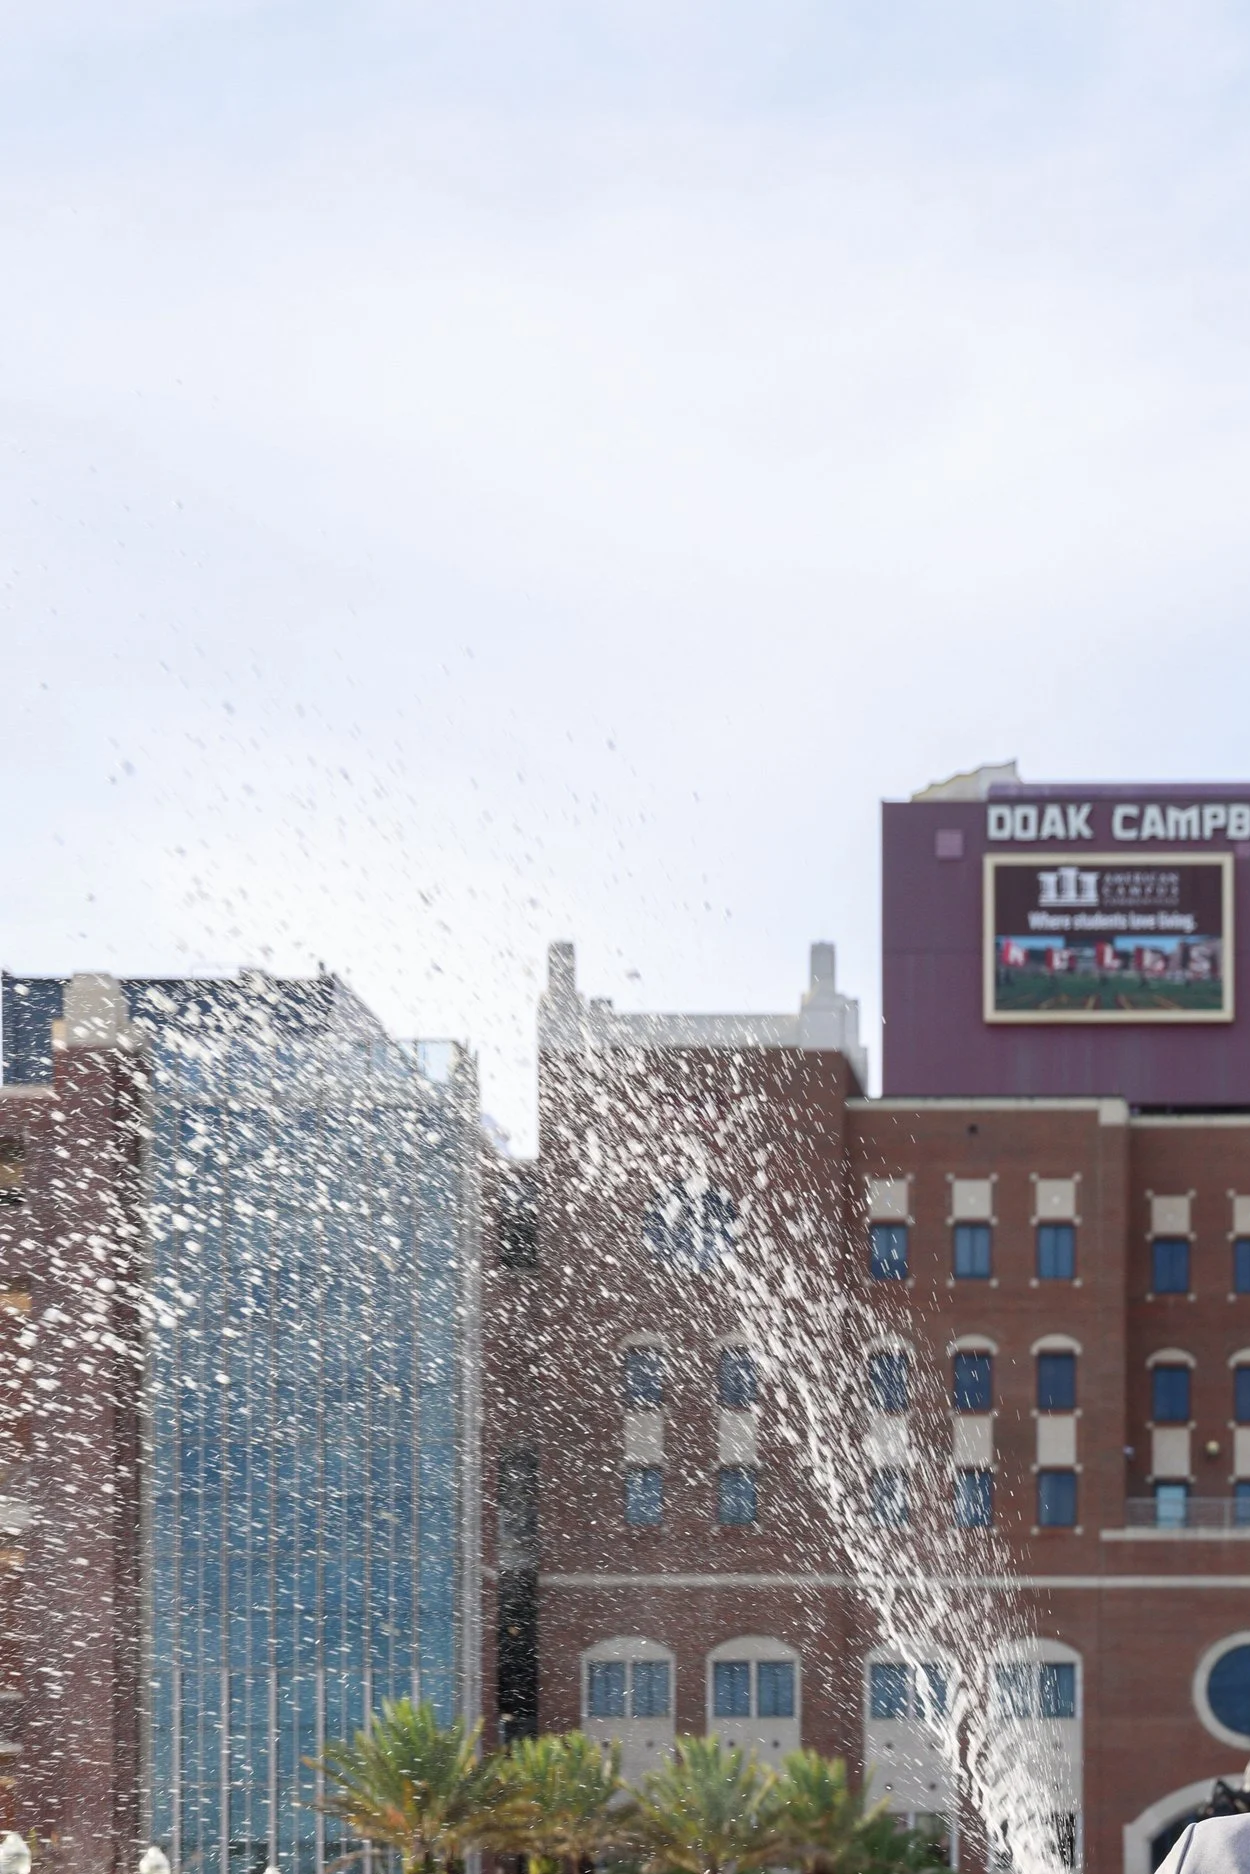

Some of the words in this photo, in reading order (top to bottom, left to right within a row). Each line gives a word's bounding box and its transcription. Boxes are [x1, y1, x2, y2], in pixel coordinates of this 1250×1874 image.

[988, 804, 1093, 840] DOAK
[1028, 911, 1072, 930] Where
[1073, 910, 1127, 930] students
